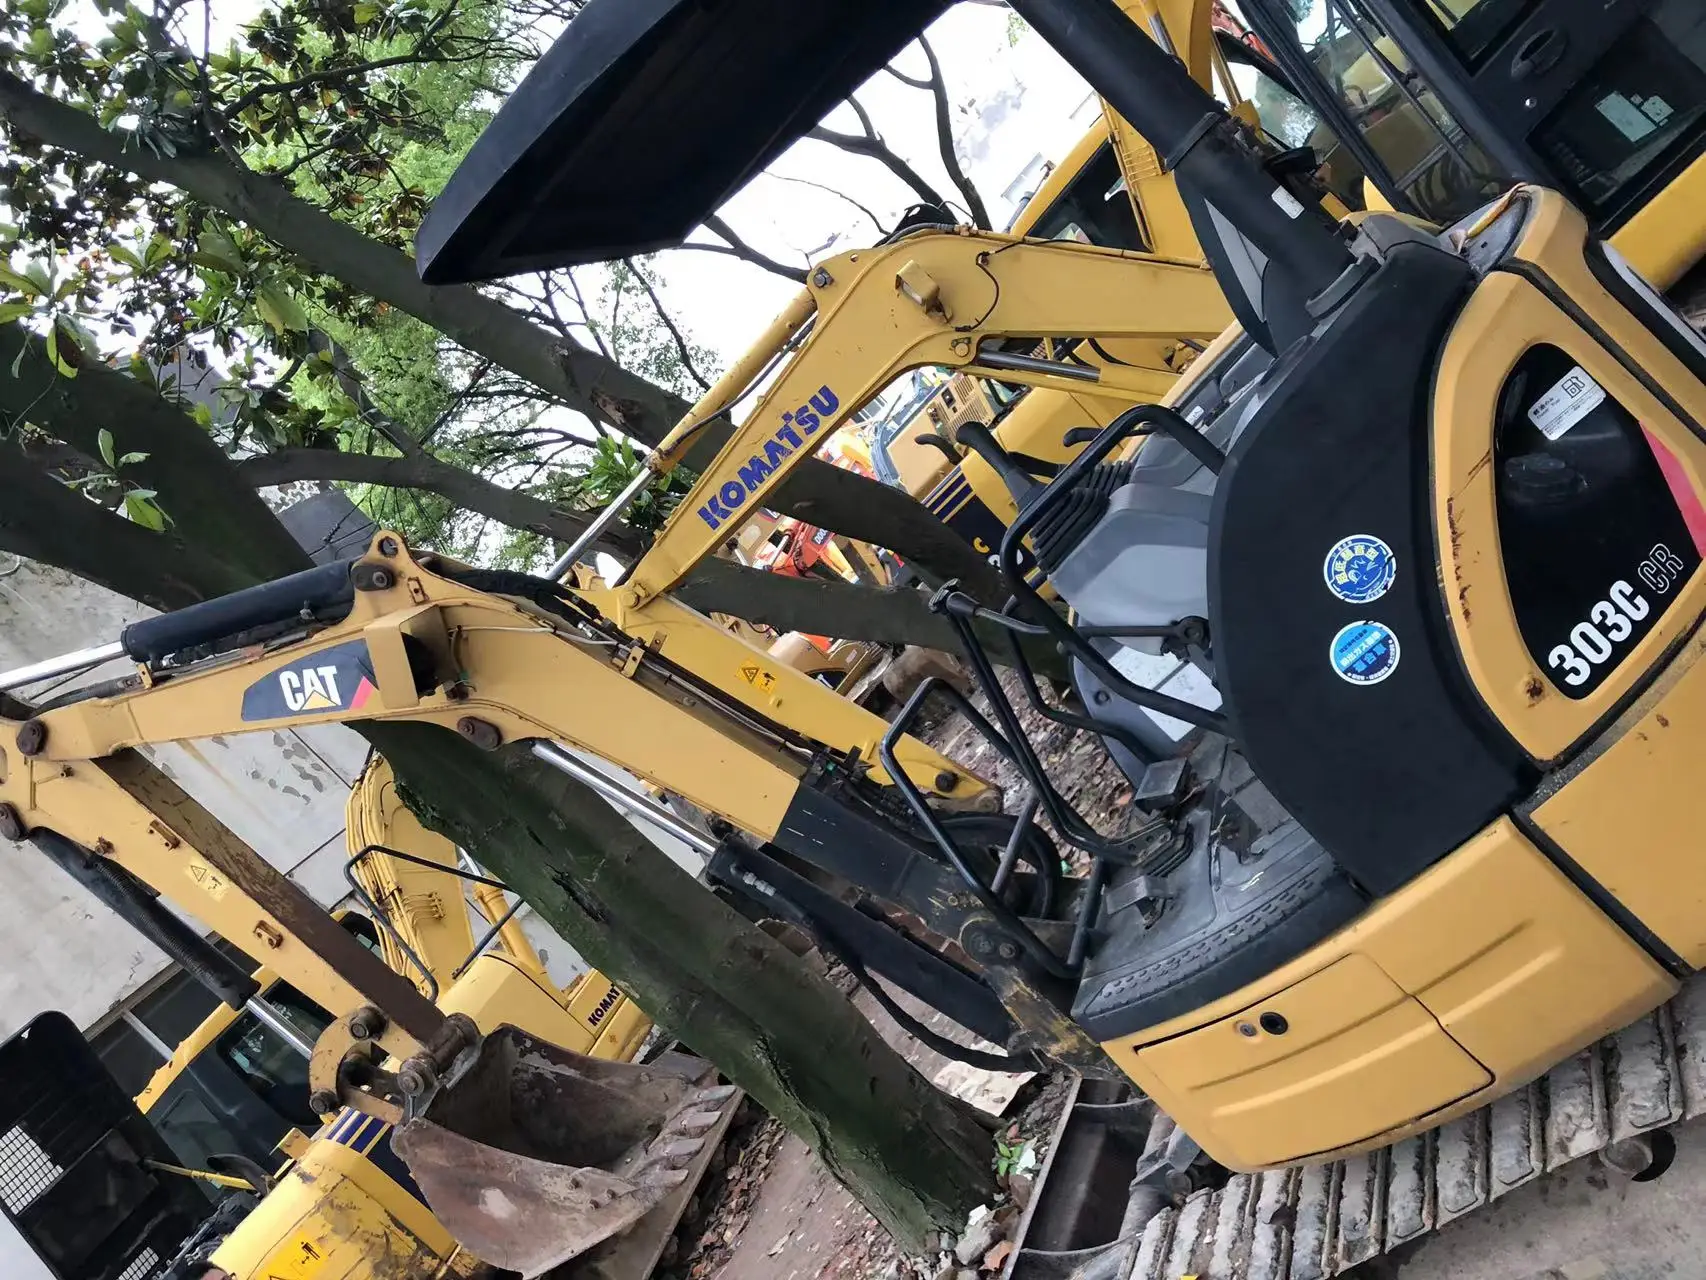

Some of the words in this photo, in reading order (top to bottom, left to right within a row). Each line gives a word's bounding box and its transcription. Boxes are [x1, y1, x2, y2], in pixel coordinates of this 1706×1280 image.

[697, 385, 839, 530] KOMATSU
[1548, 580, 1649, 686] 303C
[1638, 543, 1684, 594] CR
[279, 665, 342, 712] CAT
